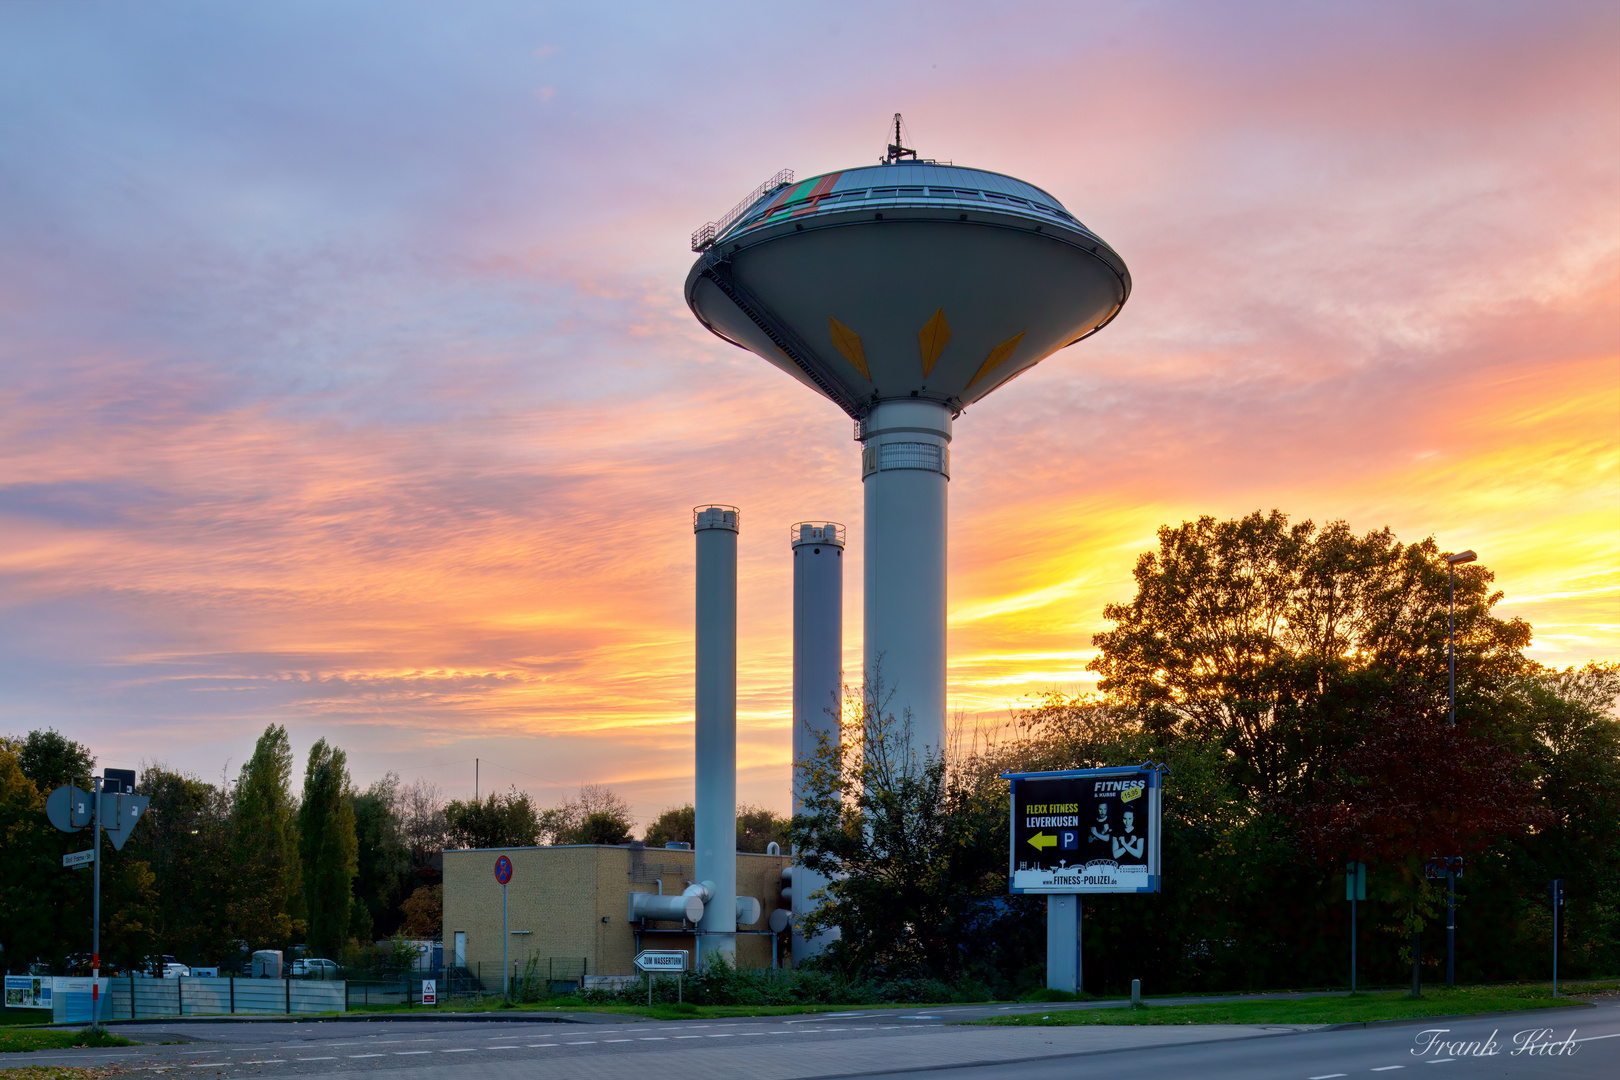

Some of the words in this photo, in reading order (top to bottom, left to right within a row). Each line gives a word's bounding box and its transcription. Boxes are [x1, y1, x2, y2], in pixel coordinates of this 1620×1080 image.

[1094, 780, 1146, 792] FITNESS
[1026, 804, 1048, 815] FLEXX
[1049, 803, 1079, 814] FITNESS
[1026, 815, 1079, 828] LEVERKUSEN
[1064, 832, 1074, 848] P
[1042, 875, 1117, 885] www.FITNESS-POLIZEI.de
[643, 956, 653, 965] ZUM
[653, 956, 682, 965] WASSERTURM
